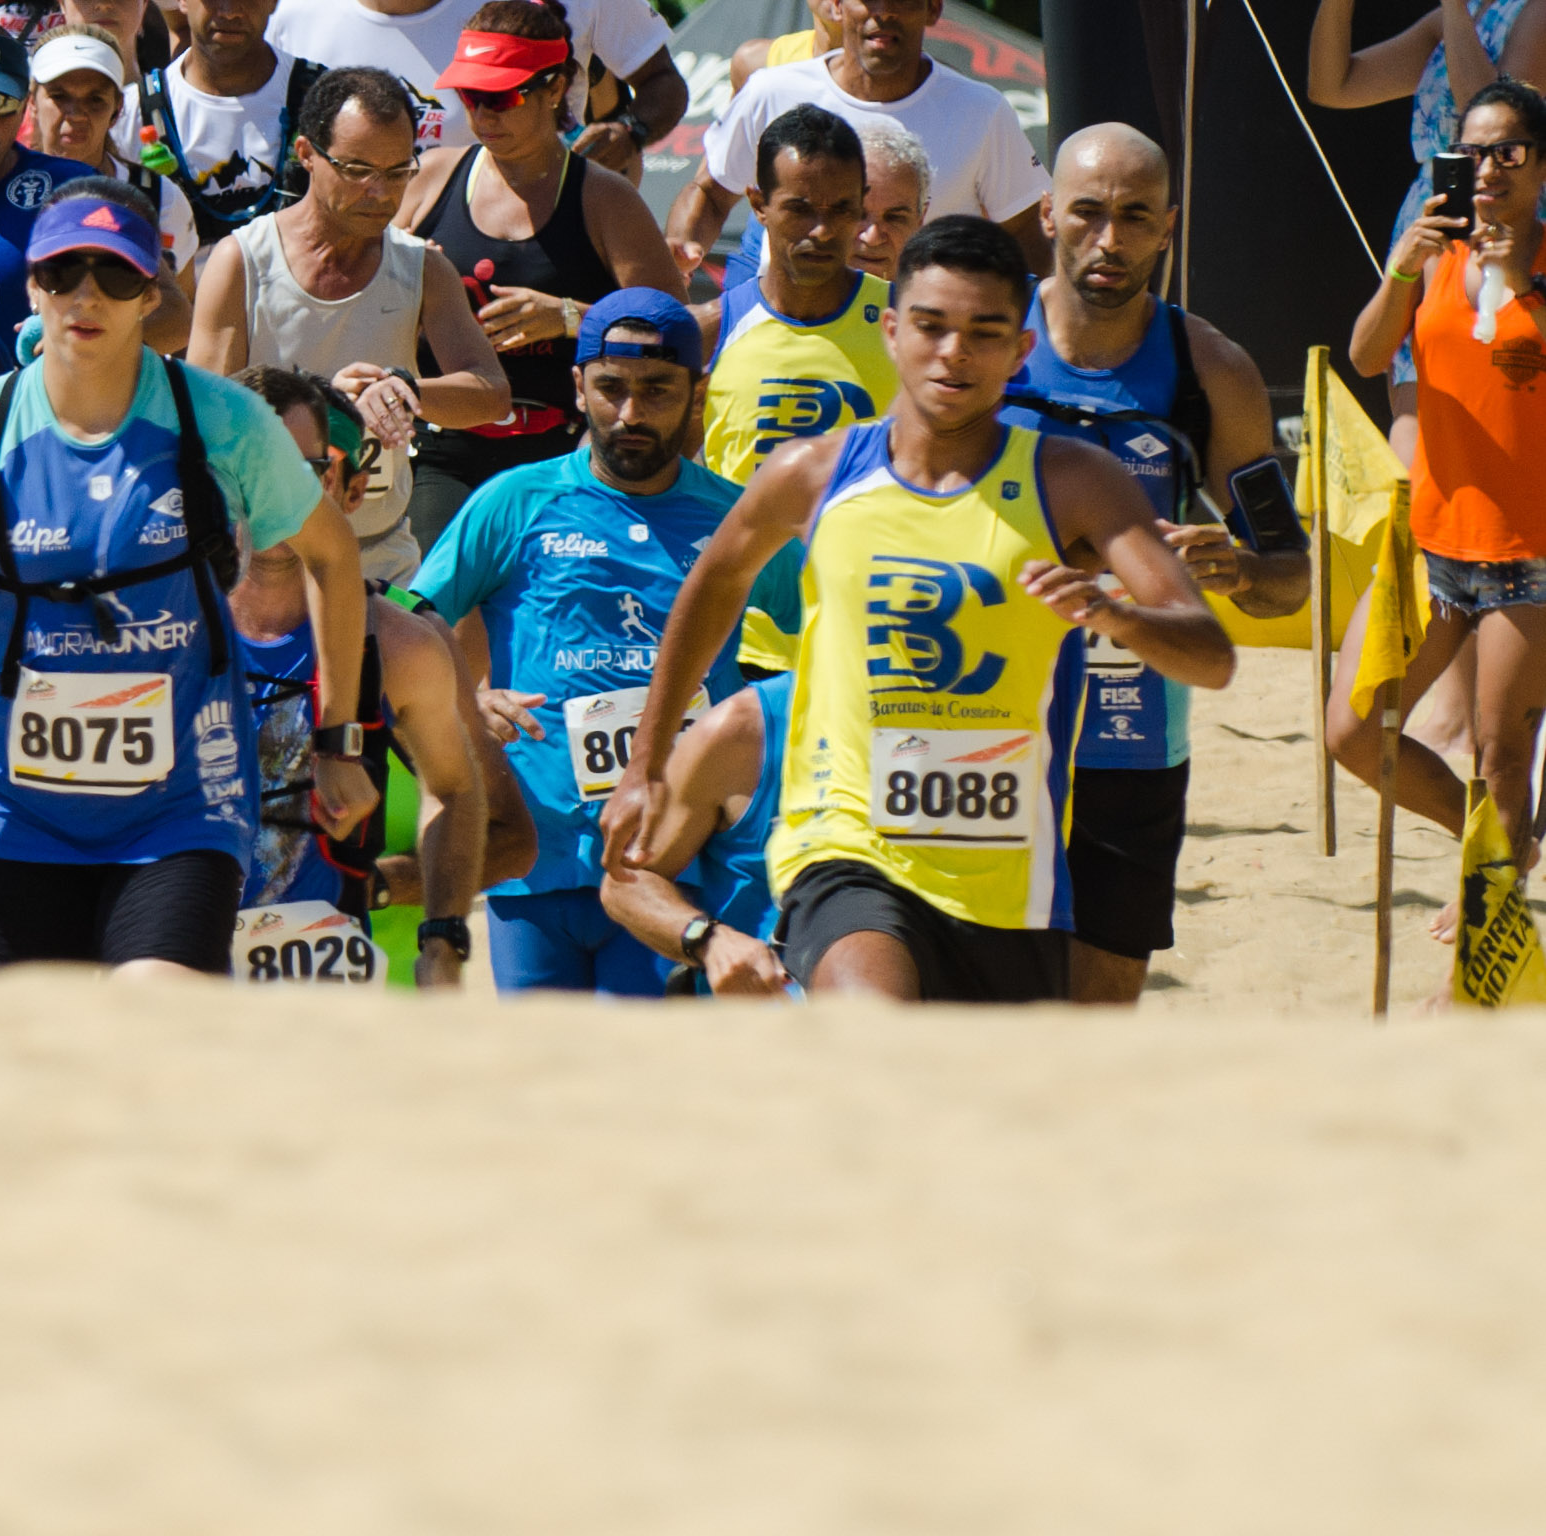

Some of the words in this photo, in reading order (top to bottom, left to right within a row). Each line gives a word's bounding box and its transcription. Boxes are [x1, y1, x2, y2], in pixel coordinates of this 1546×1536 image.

[540, 532, 609, 559] Felipe
[1099, 687, 1142, 704] FISK
[20, 712, 154, 766] 8075
[886, 770, 1018, 819] 8088
[248, 937, 375, 984] 8029
